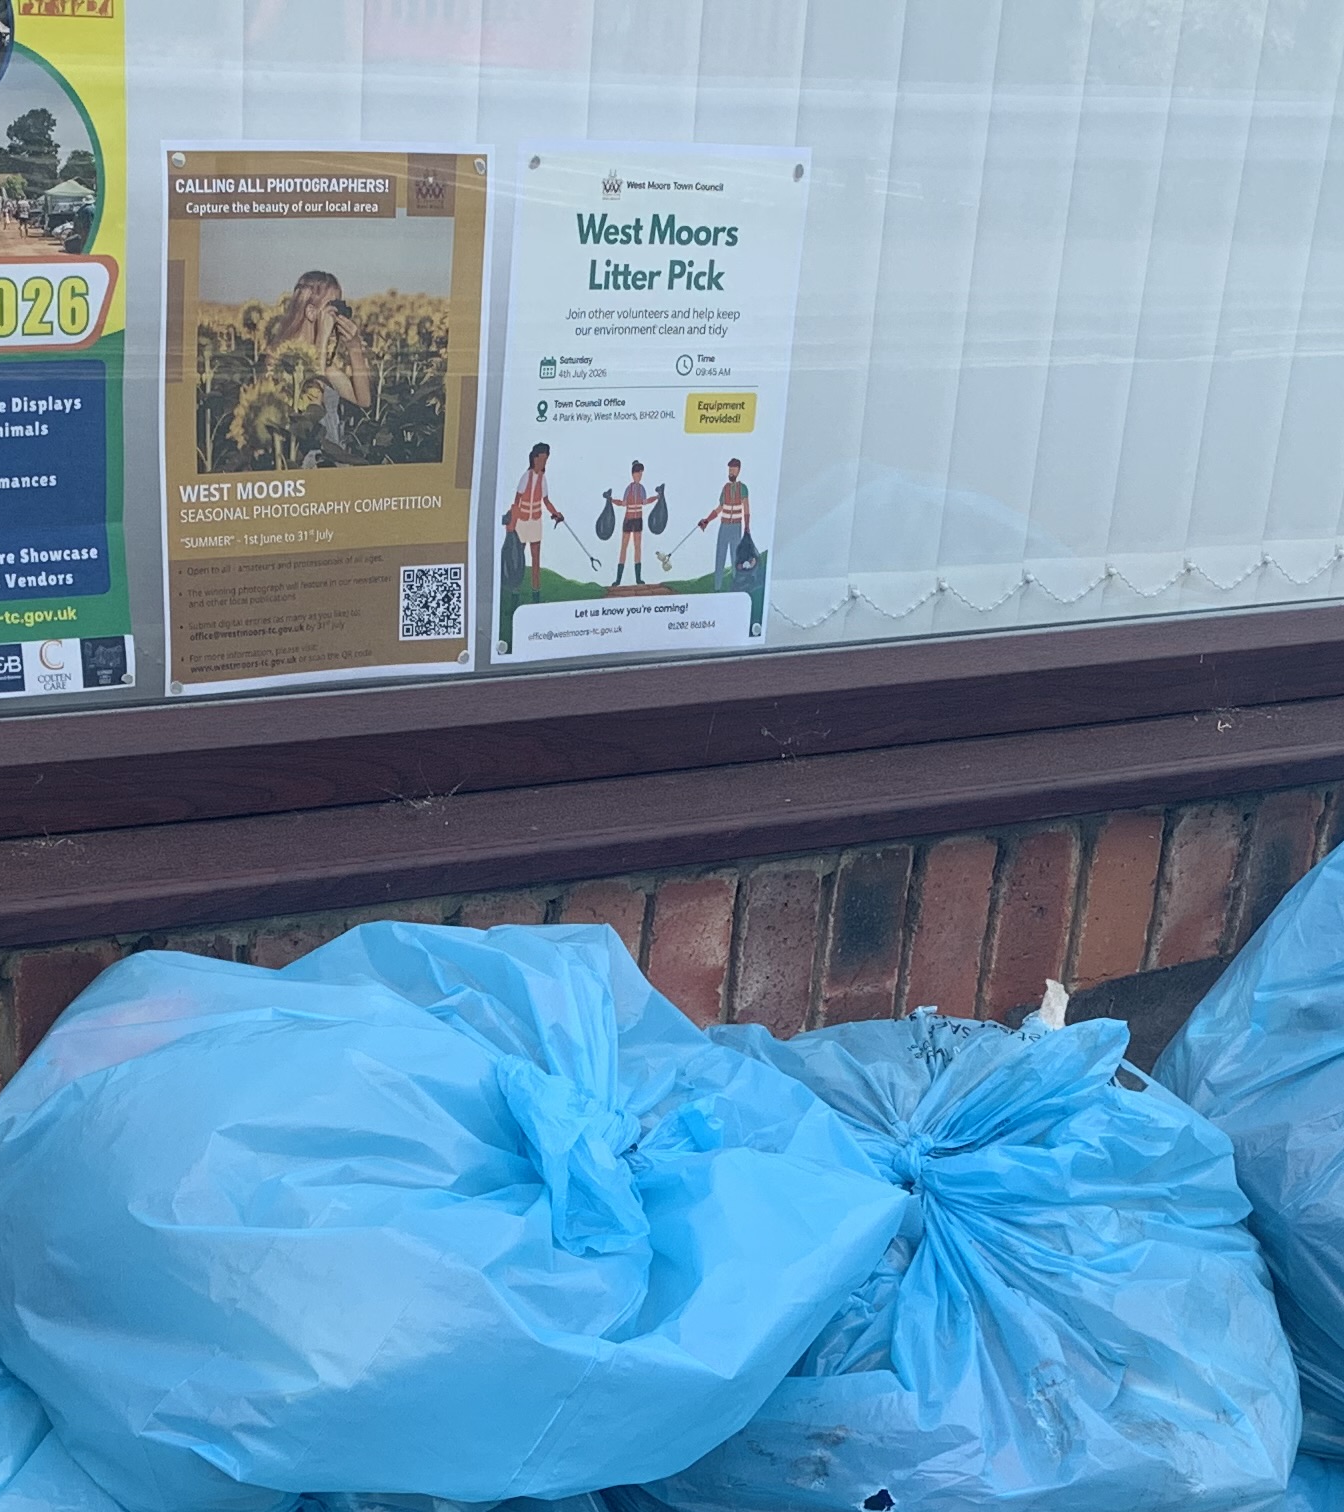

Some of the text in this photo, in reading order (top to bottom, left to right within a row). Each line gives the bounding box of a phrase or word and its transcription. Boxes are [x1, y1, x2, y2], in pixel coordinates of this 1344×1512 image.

[175, 179, 389, 194] CALLING ALL PHOTOGRAPHERS!
[186, 201, 378, 215] Capture the beauty of our local area
[577, 213, 739, 247] West Moors
[588, 259, 725, 292] Litter Pick
[565, 308, 740, 322] Join other volunteers and help keep
[576, 323, 728, 339] our environment clean and tidy
[12, 396, 82, 415] Displays
[698, 400, 745, 411] Equipment
[699, 413, 741, 424] Provided!
[179, 480, 306, 503] WEST MOORS
[180, 495, 442, 523] SEASONAL PHOTOGRAPHY COMPETITION
[243, 534, 258, 545] 1st
[260, 533, 282, 546] June
[284, 532, 295, 542] to
[316, 528, 334, 541] July
[20, 547, 98, 563] Showcase
[5, 572, 74, 588] Vendors
[575, 603, 689, 618] Let us know you're coming!
